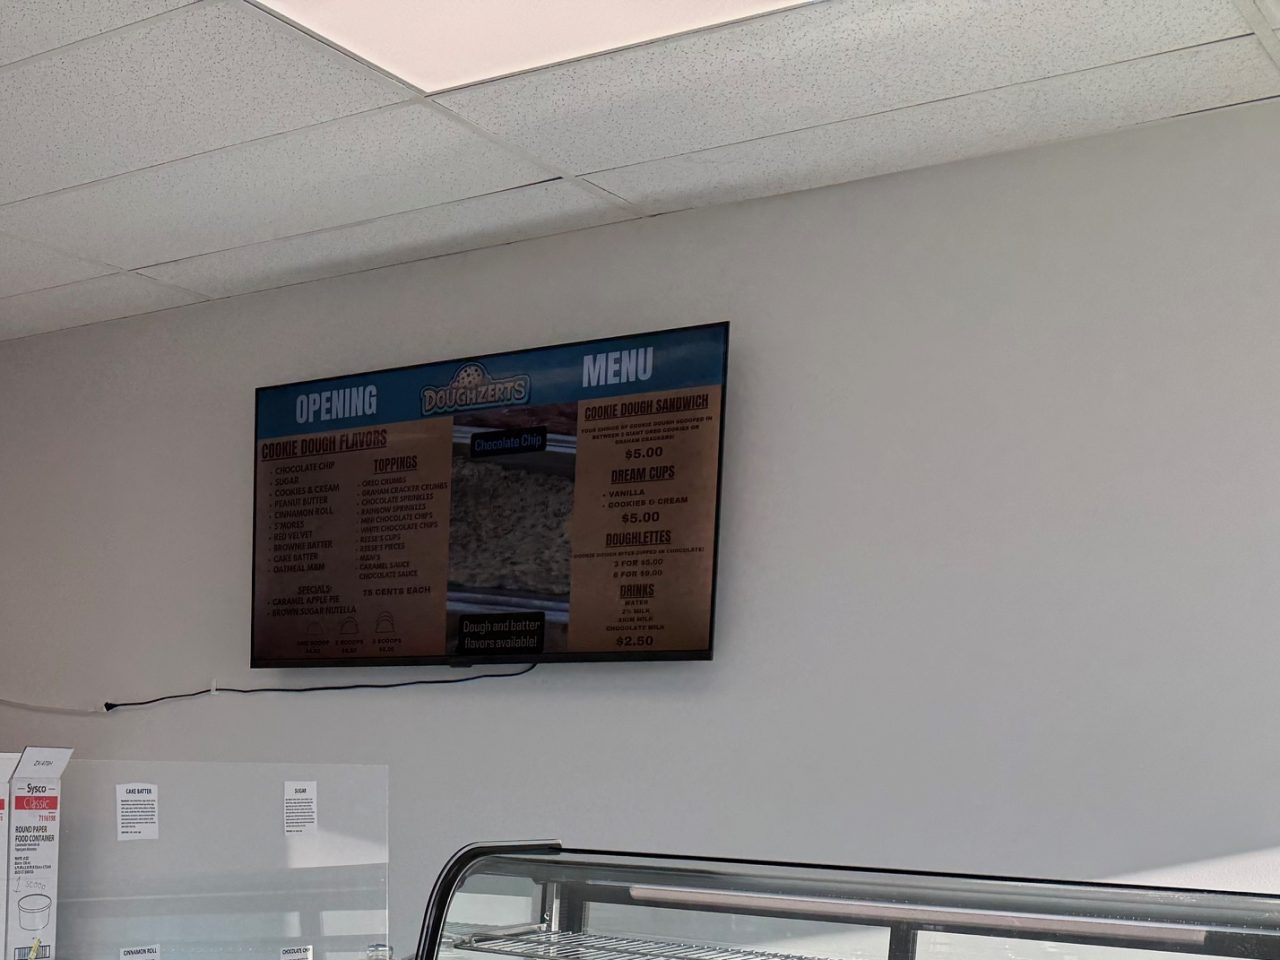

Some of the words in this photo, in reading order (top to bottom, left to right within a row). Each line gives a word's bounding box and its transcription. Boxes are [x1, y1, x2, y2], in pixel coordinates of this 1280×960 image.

[582, 347, 654, 388] MENU
[423, 379, 527, 411] DOUGHZERTS
[296, 385, 377, 424] OPENING
[584, 402, 618, 420] COOKIE
[620, 399, 654, 416] DOUGH
[656, 393, 709, 412] SANDWICH
[261, 440, 298, 460] COOKIE
[300, 436, 336, 455] DOUGH
[339, 429, 388, 450] FLAVORS
[474, 437, 520, 451] Chocolate
[521, 433, 542, 449] Chip
[624, 446, 663, 460] $5.00
[275, 463, 317, 475] CHOCOLATE
[373, 455, 417, 473] TOPPINGS
[275, 476, 300, 486] SUGAR
[611, 468, 646, 483] DREAM
[649, 465, 675, 480] CUPS
[609, 489, 646, 498] VANILLA
[608, 499, 646, 509] COOKIES
[657, 496, 689, 506] CREAM
[621, 511, 660, 525] $5.00
[606, 529, 672, 547] DOUGHLETTES
[406, 585, 431, 594] EACH
[620, 583, 656, 599] DRINKS
[463, 620, 491, 635] Dough
[492, 619, 509, 631] and
[510, 618, 540, 631] batter
[464, 637, 494, 649] flavors
[616, 635, 654, 647] $2.50
[26, 783, 47, 795] Sysco
[23, 797, 50, 810] Classic
[15, 825, 32, 833] ROUND
[33, 825, 47, 833] PAPER
[15, 834, 29, 842] FOOD
[29, 834, 55, 843] CONTAINER
[123, 948, 146, 956] CINNAMON
